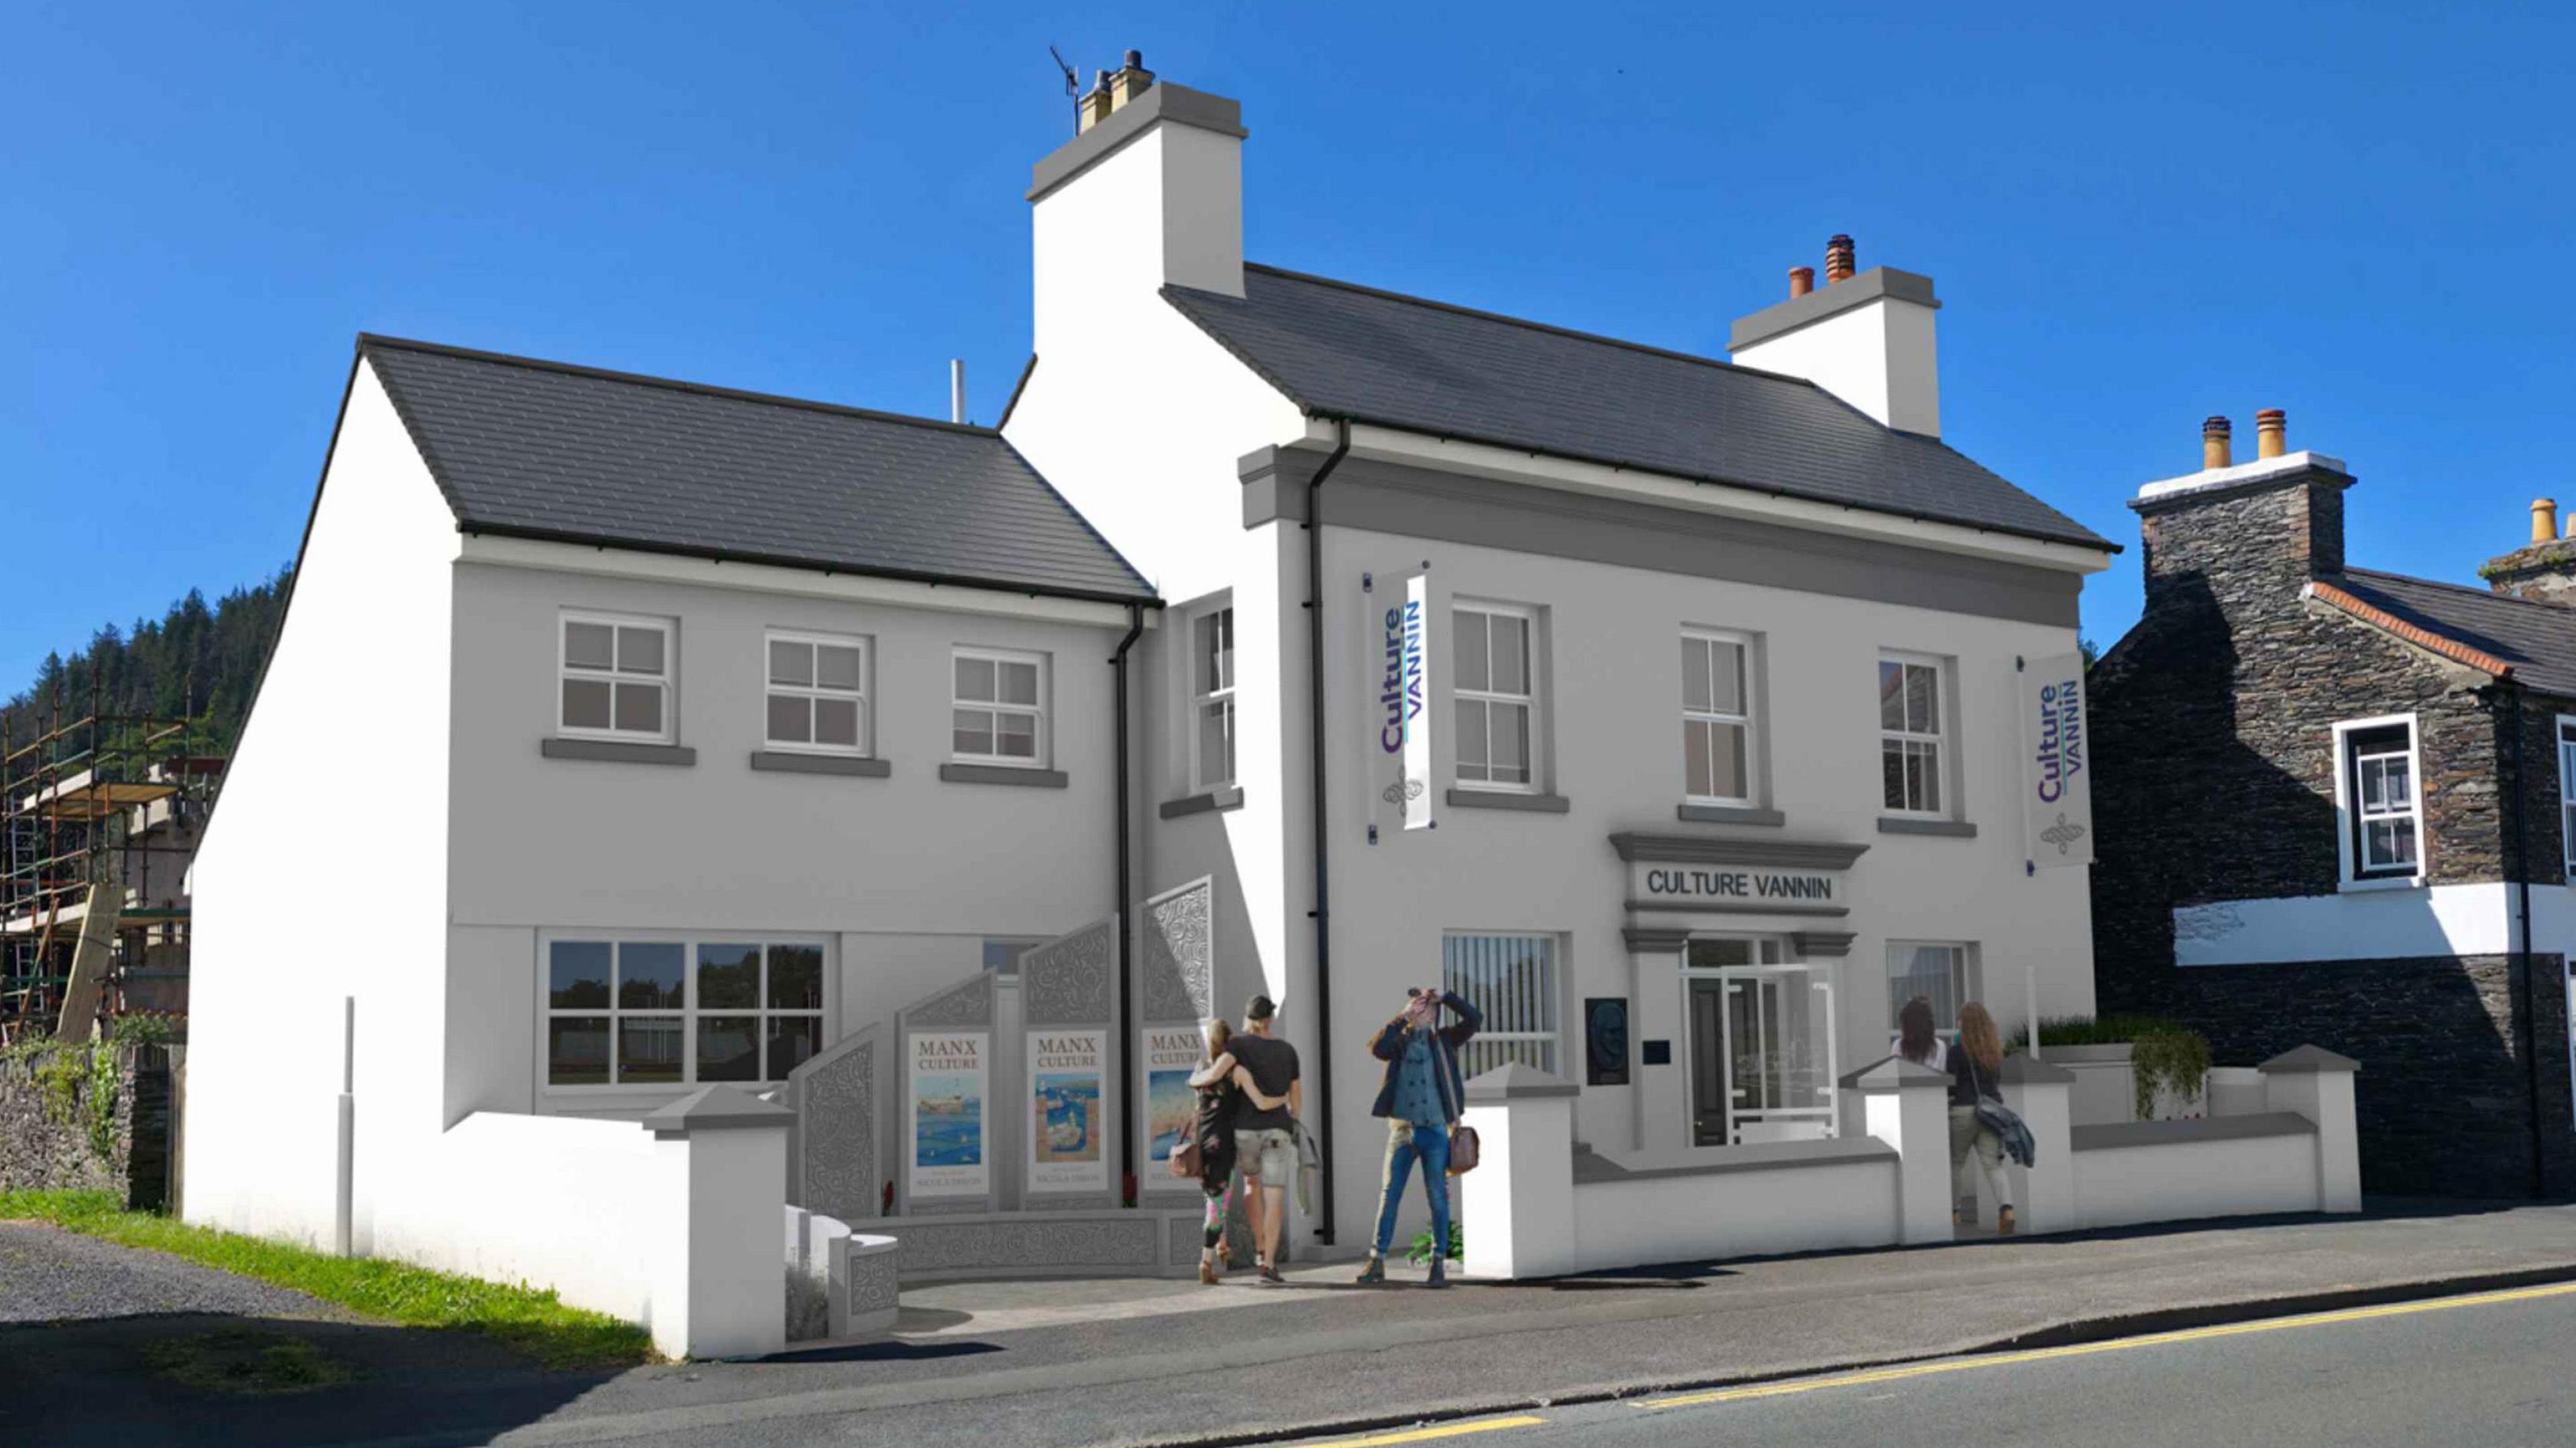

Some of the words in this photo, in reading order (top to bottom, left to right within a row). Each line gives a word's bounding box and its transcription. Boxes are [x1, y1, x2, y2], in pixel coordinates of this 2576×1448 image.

[1381, 607, 1403, 754] Culture
[2037, 684, 2061, 803] Culture
[1648, 869, 1748, 896] CULTURE
[1755, 874, 1832, 899] VANNIN
[918, 1040, 977, 1056] MANX
[1037, 1037, 1097, 1053] MANX
[918, 1058, 978, 1070] CULTURE
[1037, 1055, 1097, 1068] CULTURE
